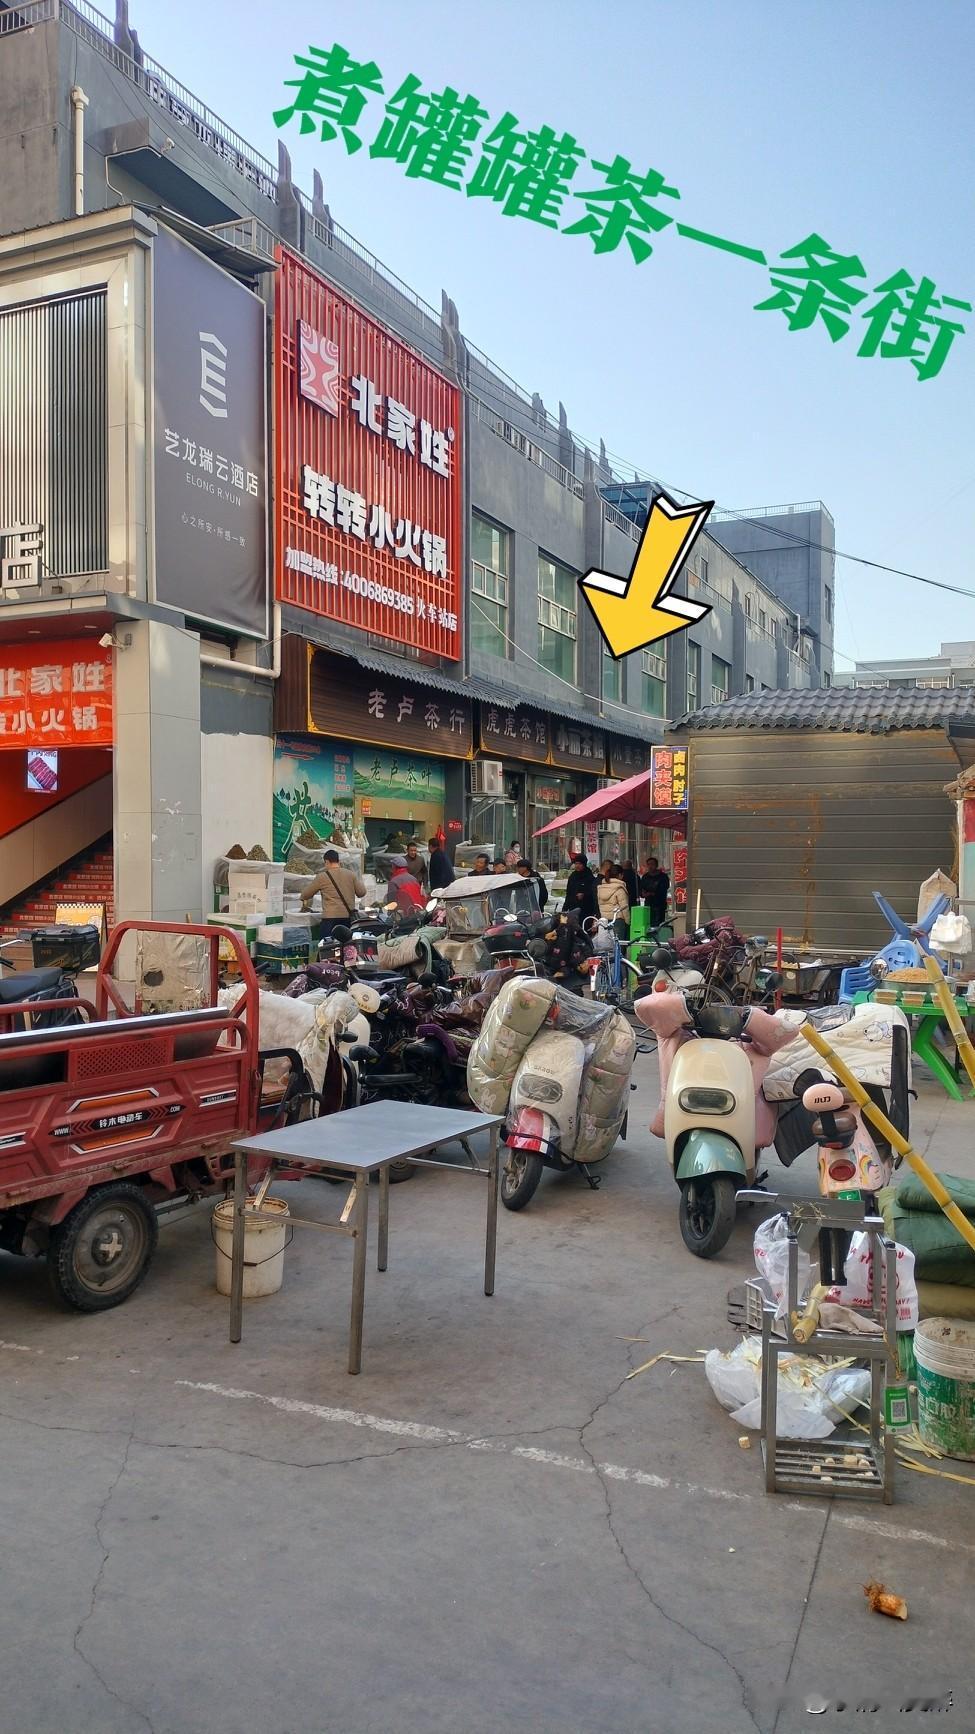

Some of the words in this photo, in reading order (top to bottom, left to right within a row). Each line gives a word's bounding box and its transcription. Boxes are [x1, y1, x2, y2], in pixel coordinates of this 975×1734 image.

[351, 374, 449, 478] 北家姓
[164, 427, 259, 497] 艺龙瑞云酒店
[186, 472, 215, 494] ELONG
[303, 463, 447, 579] 转转小火锅
[416, 596, 457, 632] 火车站店
[0, 706, 98, 735] 小火锅
[368, 687, 465, 735] 老卢茶行
[486, 706, 546, 745] 虎虎茶馆
[370, 756, 433, 791] 老卢茶叶
[654, 750, 672, 806] 肉夹馍
[99, 1112, 142, 1128] 铃木电动车
